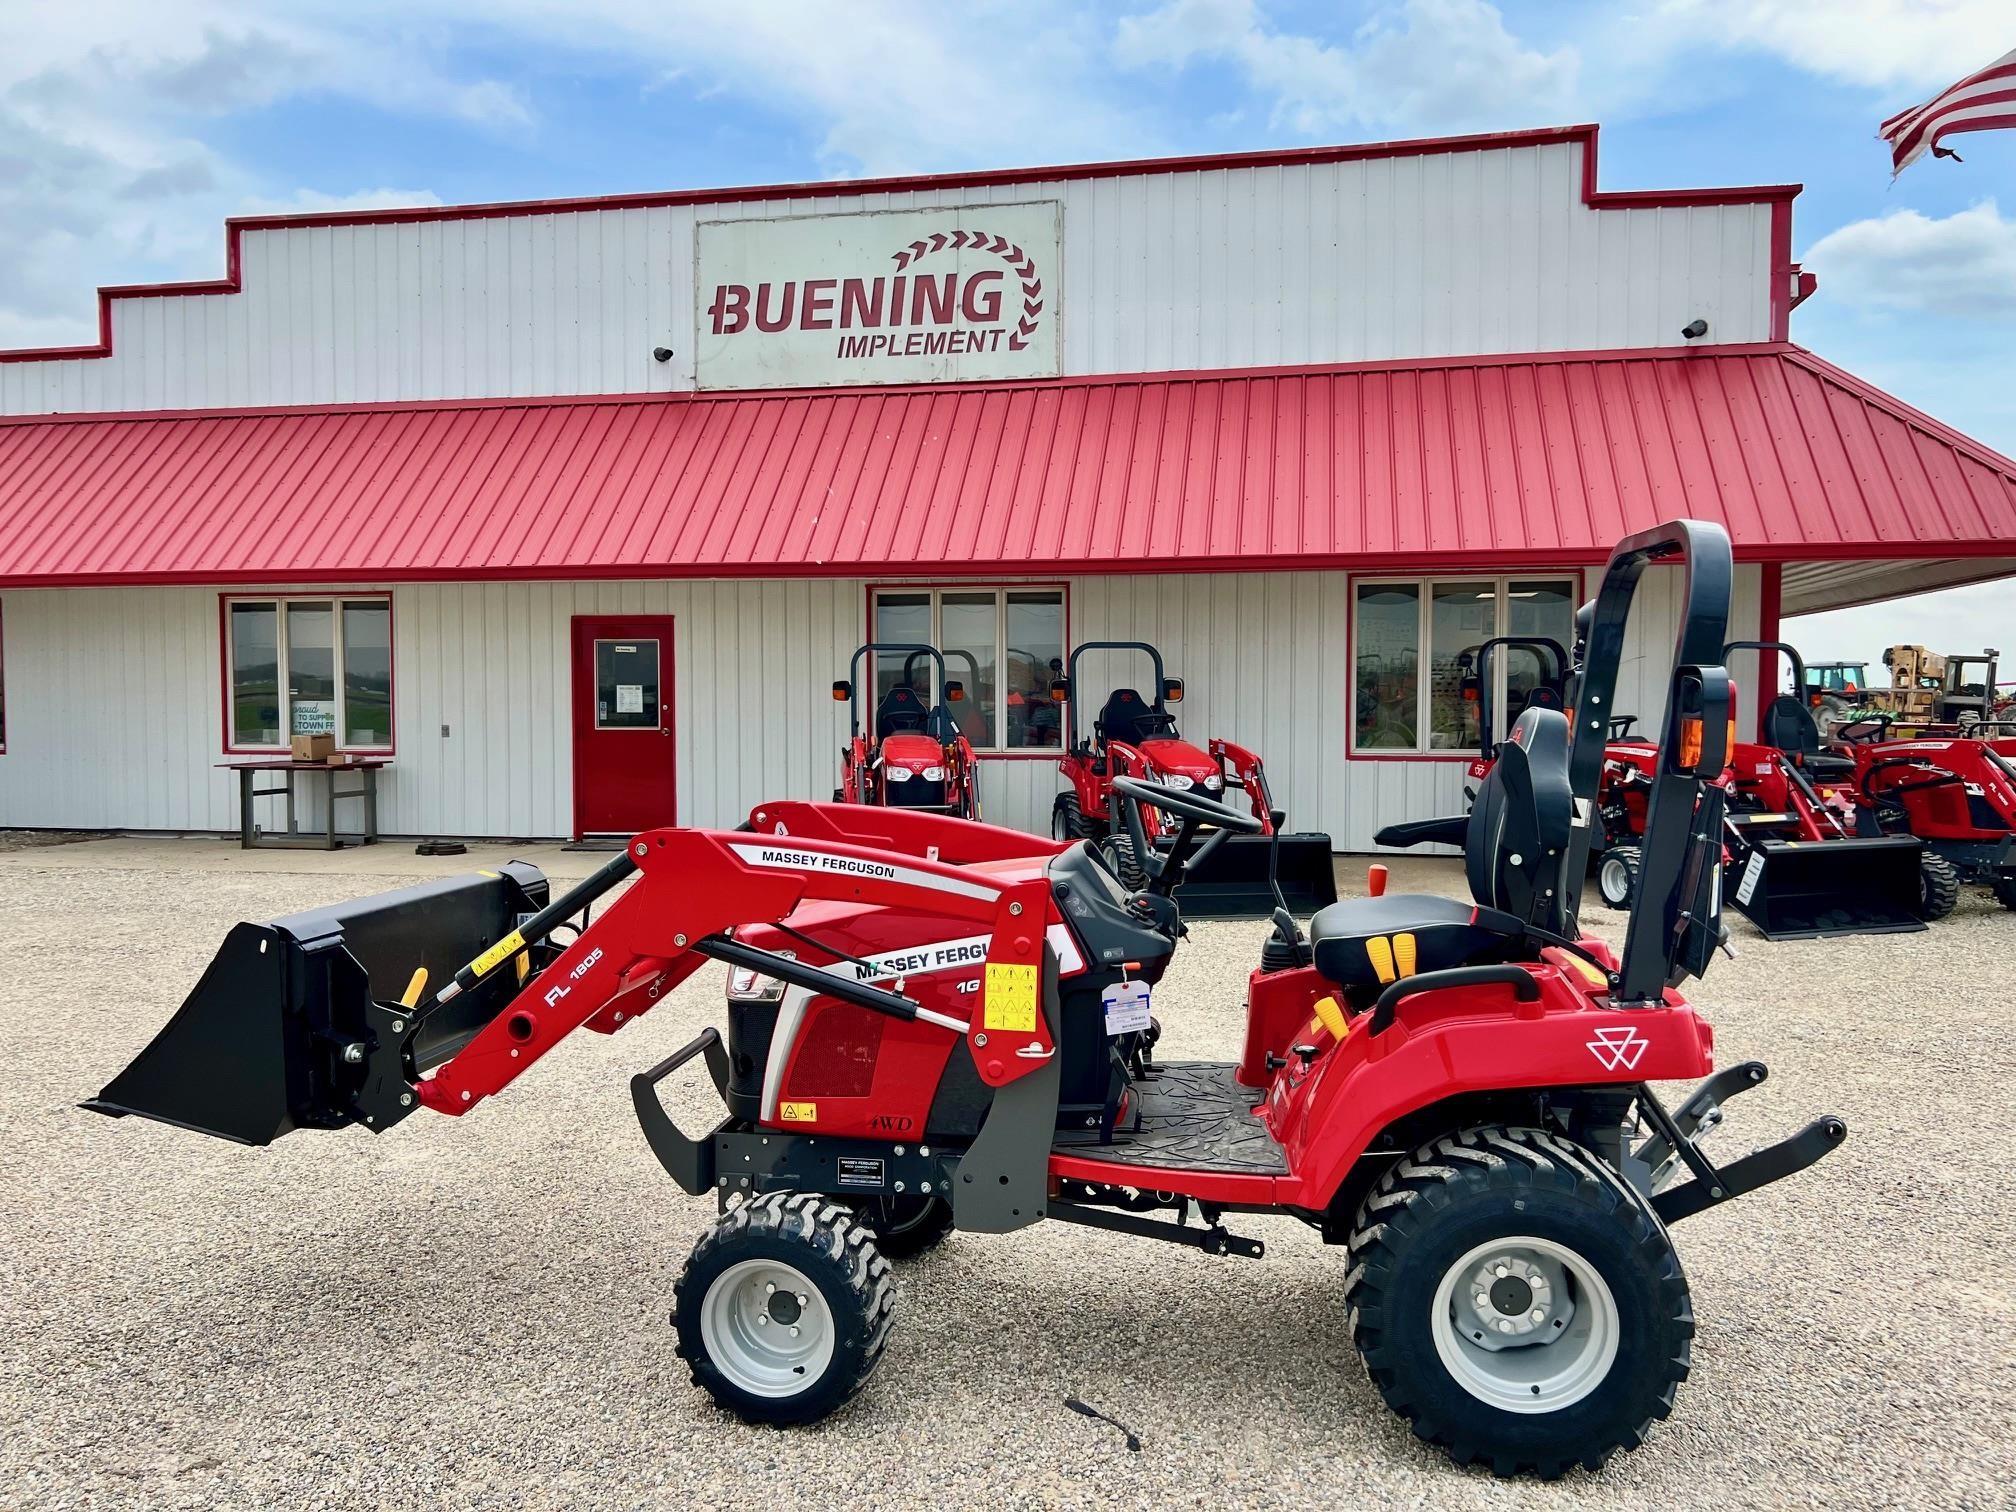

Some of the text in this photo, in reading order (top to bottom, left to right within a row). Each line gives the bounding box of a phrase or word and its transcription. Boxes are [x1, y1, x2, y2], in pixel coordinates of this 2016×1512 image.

[708, 270, 1004, 335] BUENING
[837, 329, 1005, 359] IMPLEMENT
[762, 851, 895, 878] MASSEY FERGUSON
[544, 947, 604, 1008] FL 1805
